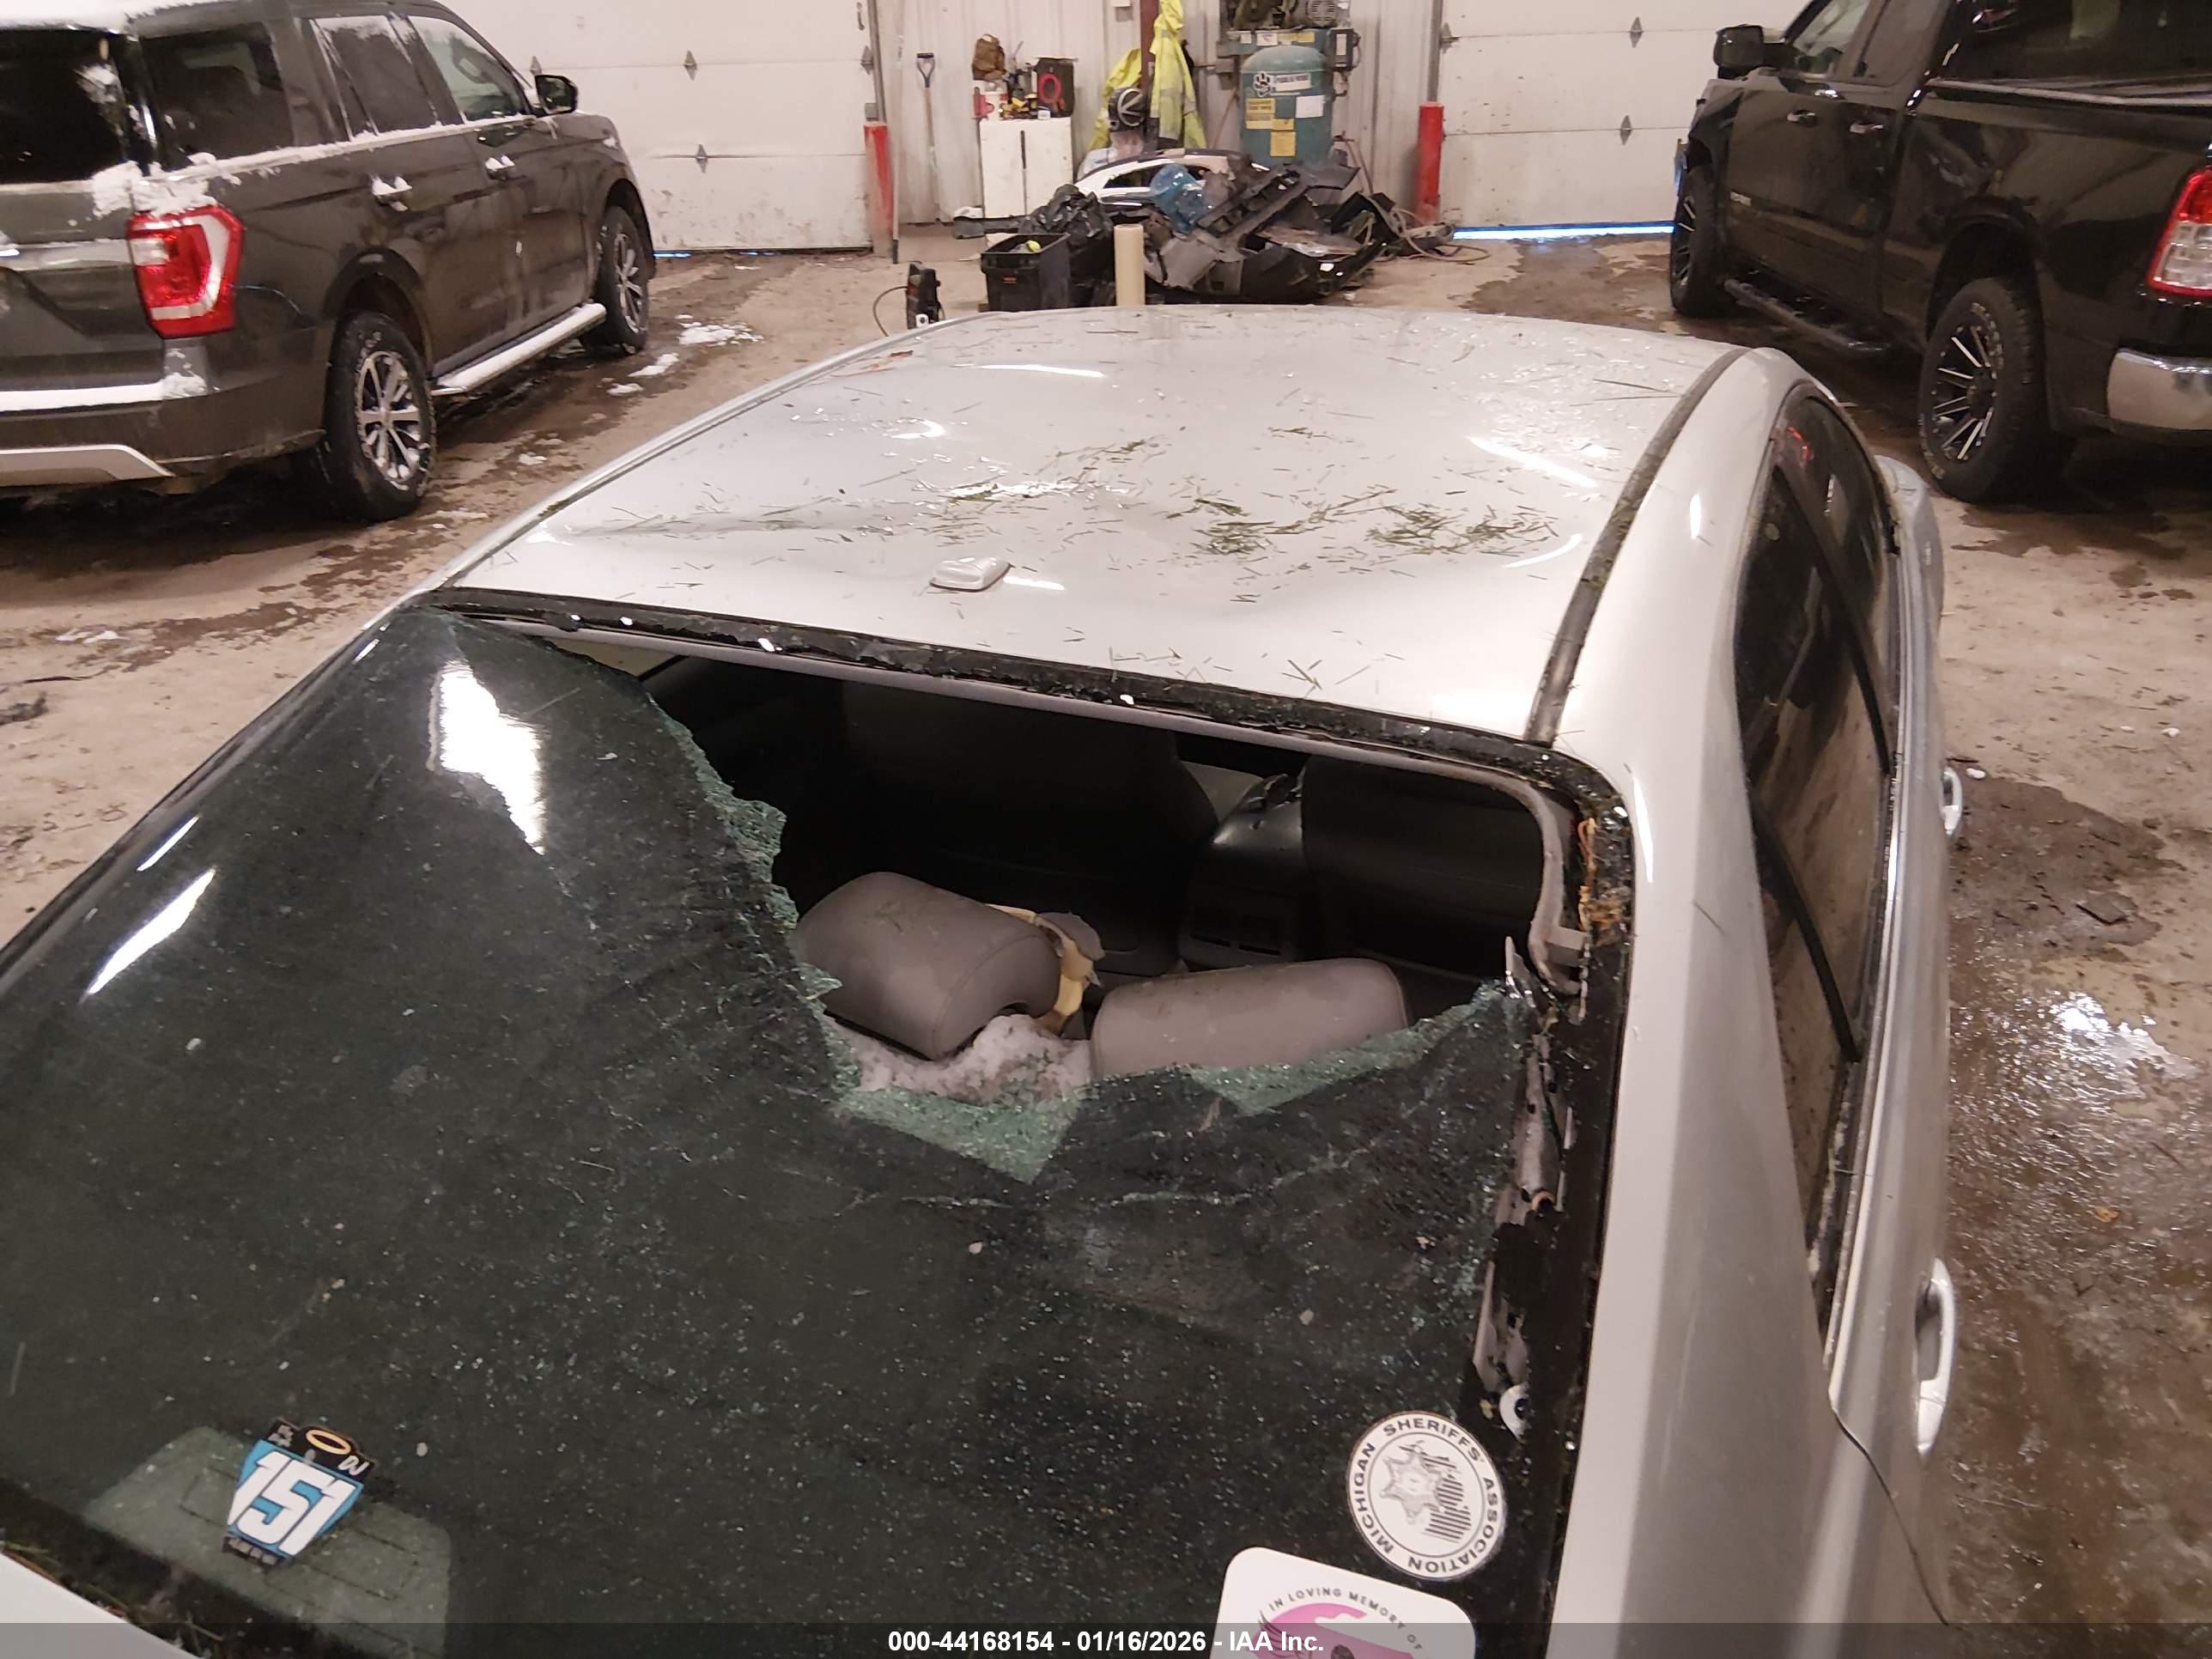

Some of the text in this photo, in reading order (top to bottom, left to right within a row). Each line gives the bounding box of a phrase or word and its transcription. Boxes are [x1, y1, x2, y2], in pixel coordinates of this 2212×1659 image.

[227, 1450, 356, 1556] 151
[1353, 1443, 1395, 1554] MICHIGAN
[1407, 1477, 1498, 1573] ASSOCIATION
[1268, 1587, 1423, 1650] IN LOVING MEMORY OF
